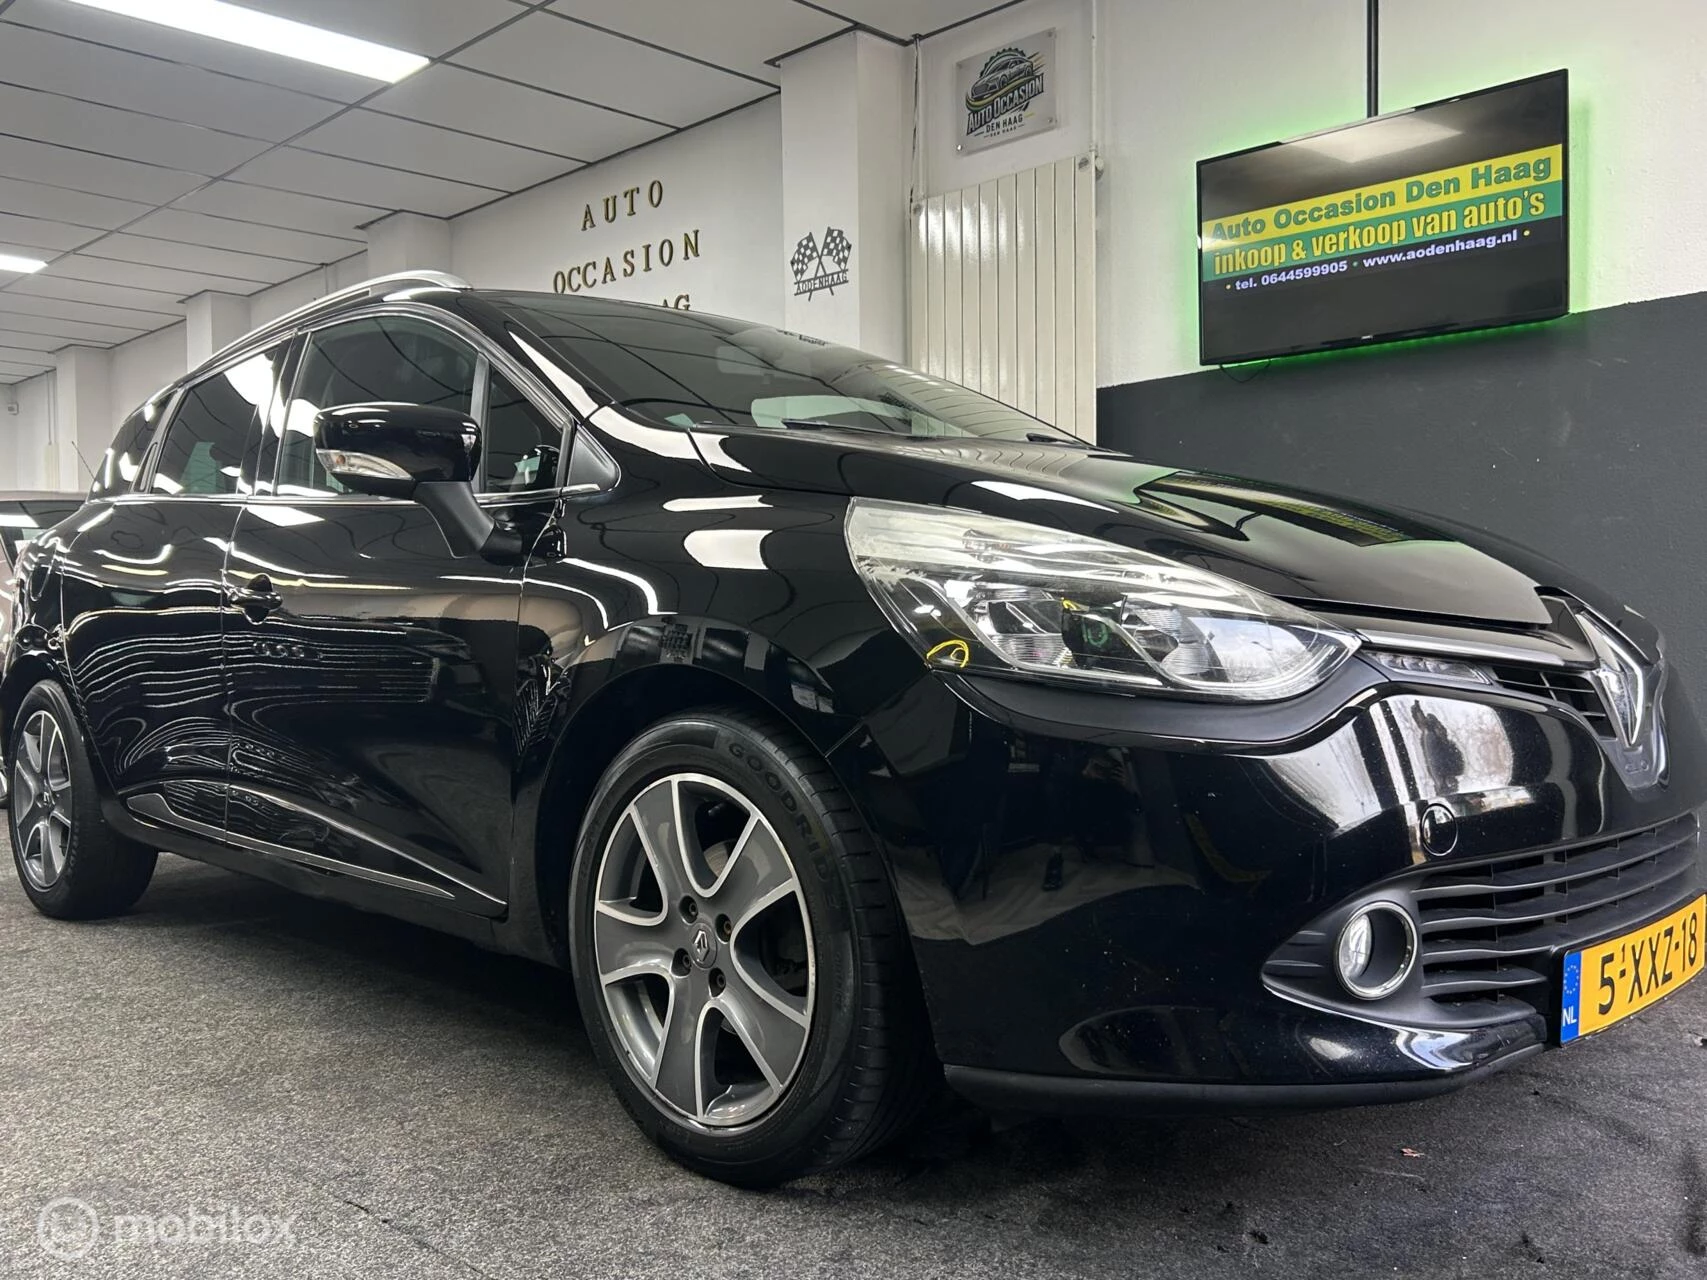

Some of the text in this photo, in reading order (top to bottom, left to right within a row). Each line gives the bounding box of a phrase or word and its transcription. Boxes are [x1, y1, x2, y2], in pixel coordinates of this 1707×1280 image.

[967, 73, 1044, 135] AUTO OCCASION
[986, 121, 1001, 133] DEN
[1002, 113, 1023, 127] HAAG
[581, 180, 663, 231] AUTO
[1212, 156, 1552, 241] Auto Occasion Den Haag
[553, 229, 700, 294] OCCASION
[1214, 190, 1546, 275] inkoop & verkoop van auto's
[1235, 229, 1518, 290] tel. 0644599905 www.aodenhaag.nl
[1598, 911, 1698, 1016] 5-XXZ-18
[1562, 1006, 1577, 1027] NL
